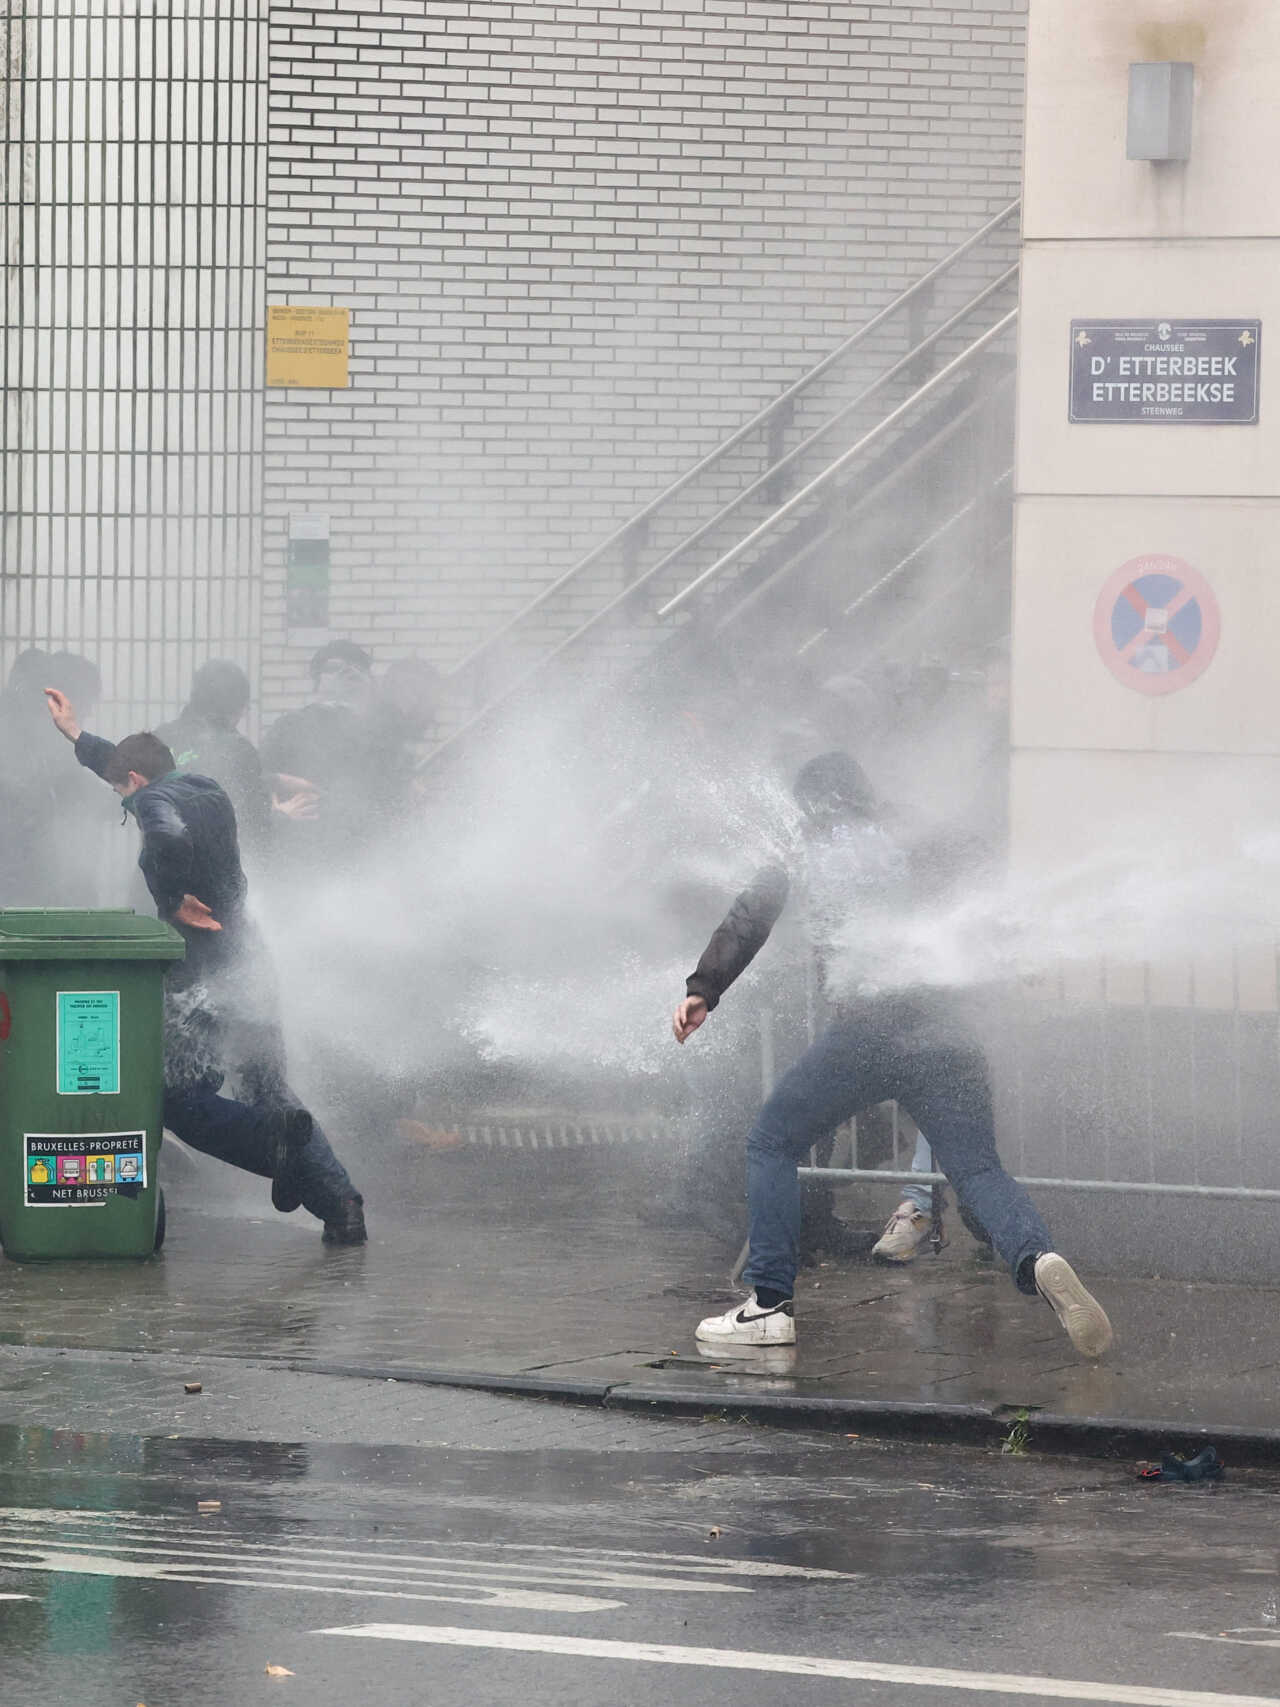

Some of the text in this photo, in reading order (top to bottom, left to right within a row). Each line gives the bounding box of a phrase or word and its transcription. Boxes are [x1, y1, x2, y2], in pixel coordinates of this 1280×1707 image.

[1090, 356, 1238, 376] D' ETTERBEEK
[1092, 382, 1235, 402] ETTERBEEKSE
[1141, 407, 1183, 416] STEENWEG
[52, 1188, 72, 1198] NET
